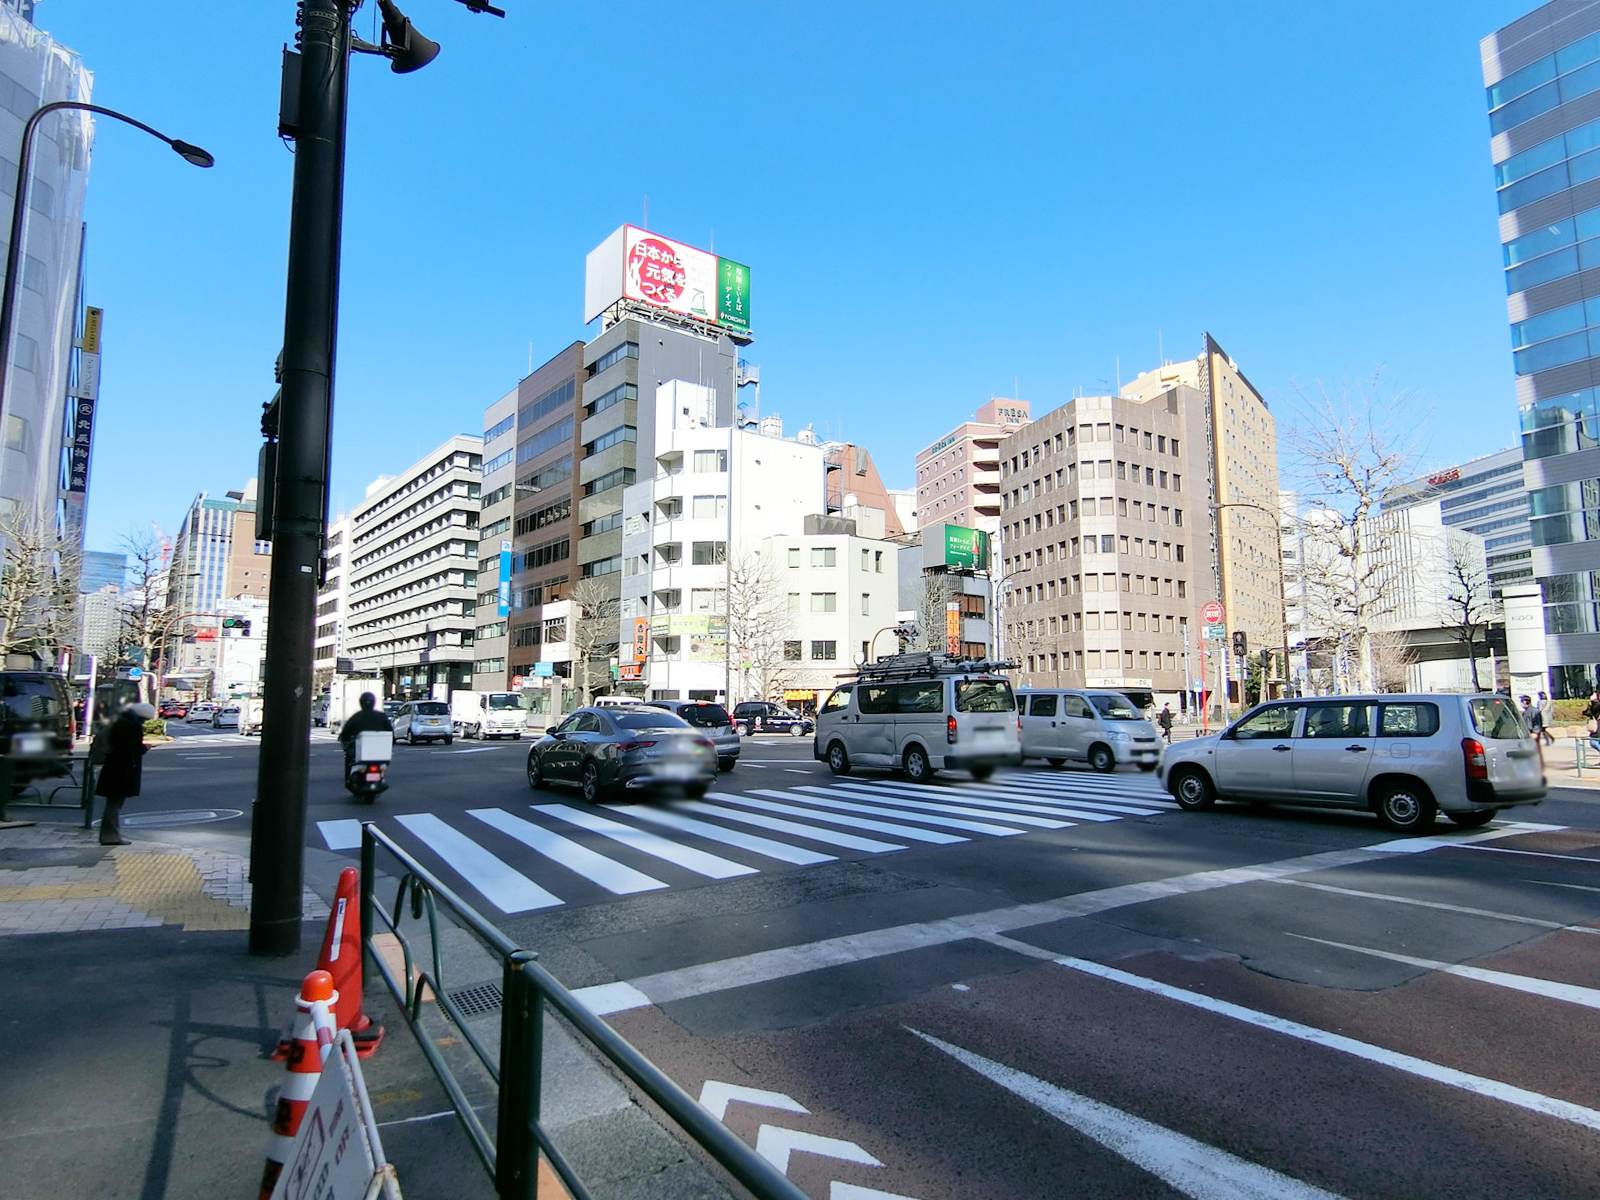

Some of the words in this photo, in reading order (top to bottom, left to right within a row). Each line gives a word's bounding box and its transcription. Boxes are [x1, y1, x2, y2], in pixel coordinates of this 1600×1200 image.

[636, 242, 684, 268] 日本から
[646, 263, 686, 288] 元気を
[642, 282, 677, 302] つくる
